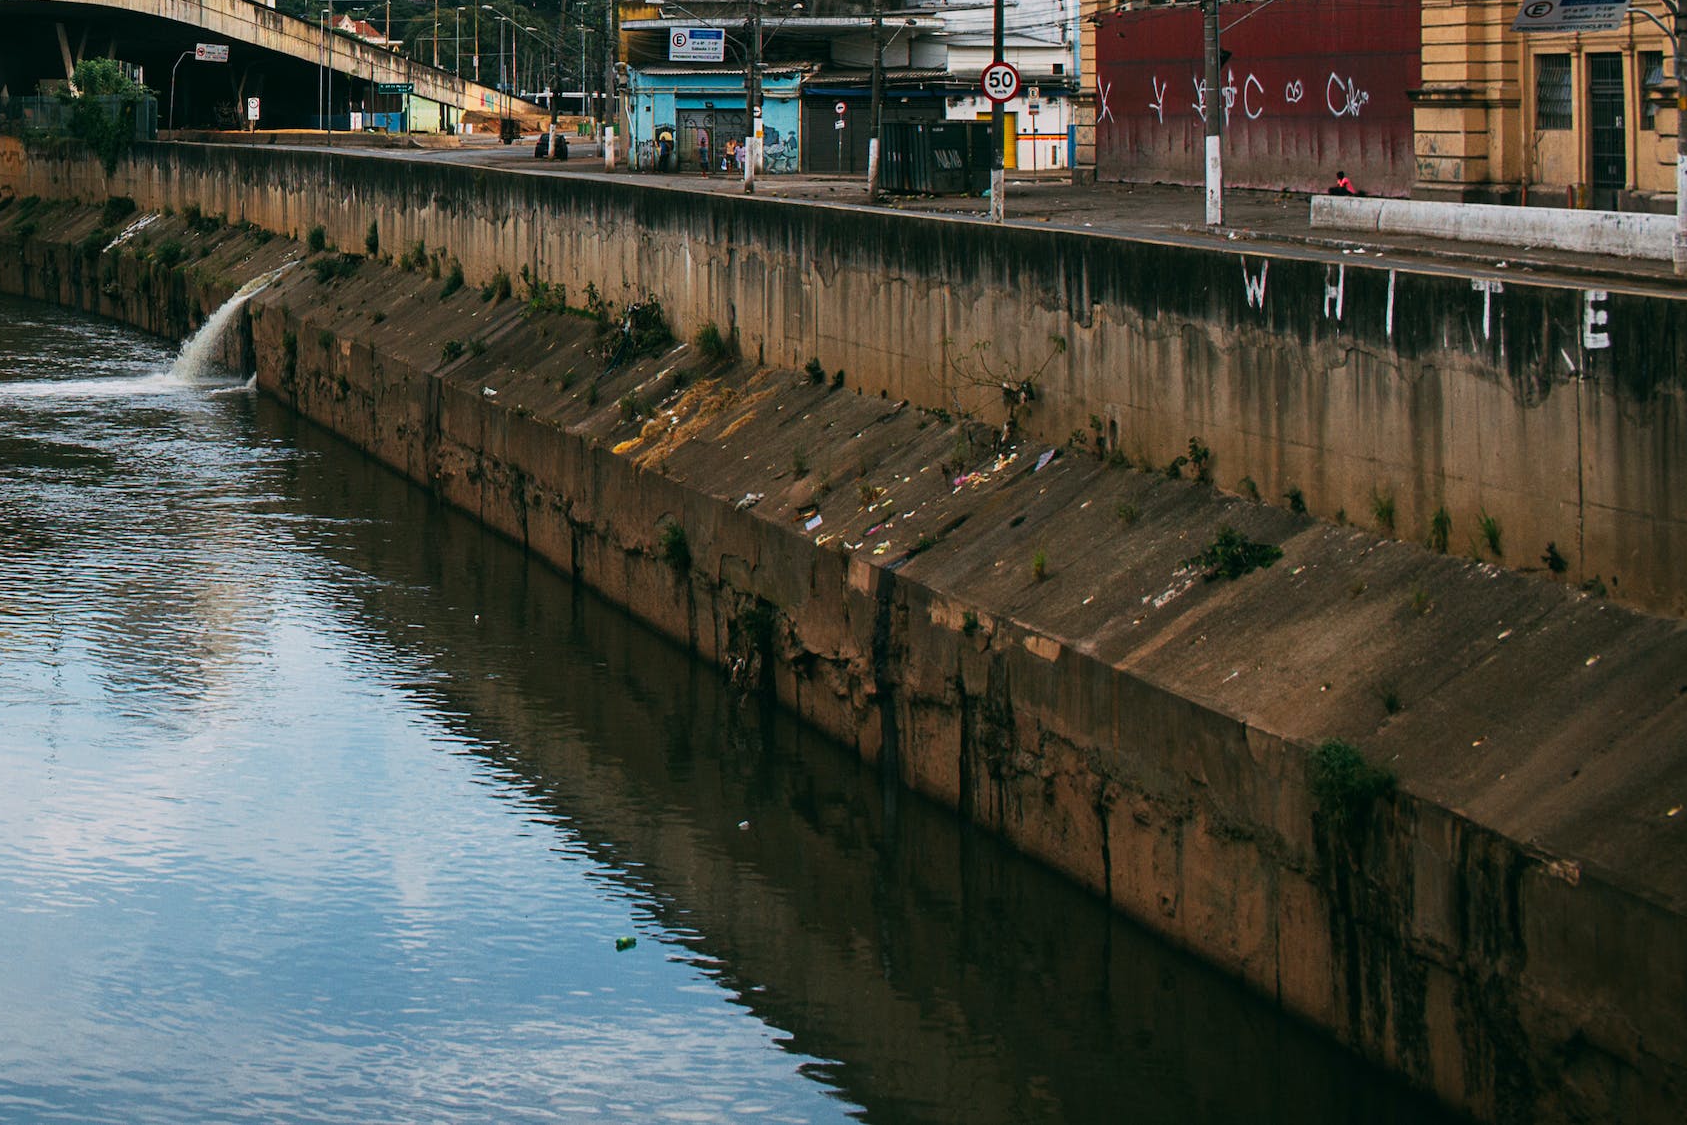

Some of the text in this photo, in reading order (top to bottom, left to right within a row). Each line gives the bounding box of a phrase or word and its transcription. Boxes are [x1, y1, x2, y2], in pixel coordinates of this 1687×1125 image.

[1532, 5, 1545, 15] E
[677, 36, 682, 44] E
[989, 71, 1013, 88] 50
